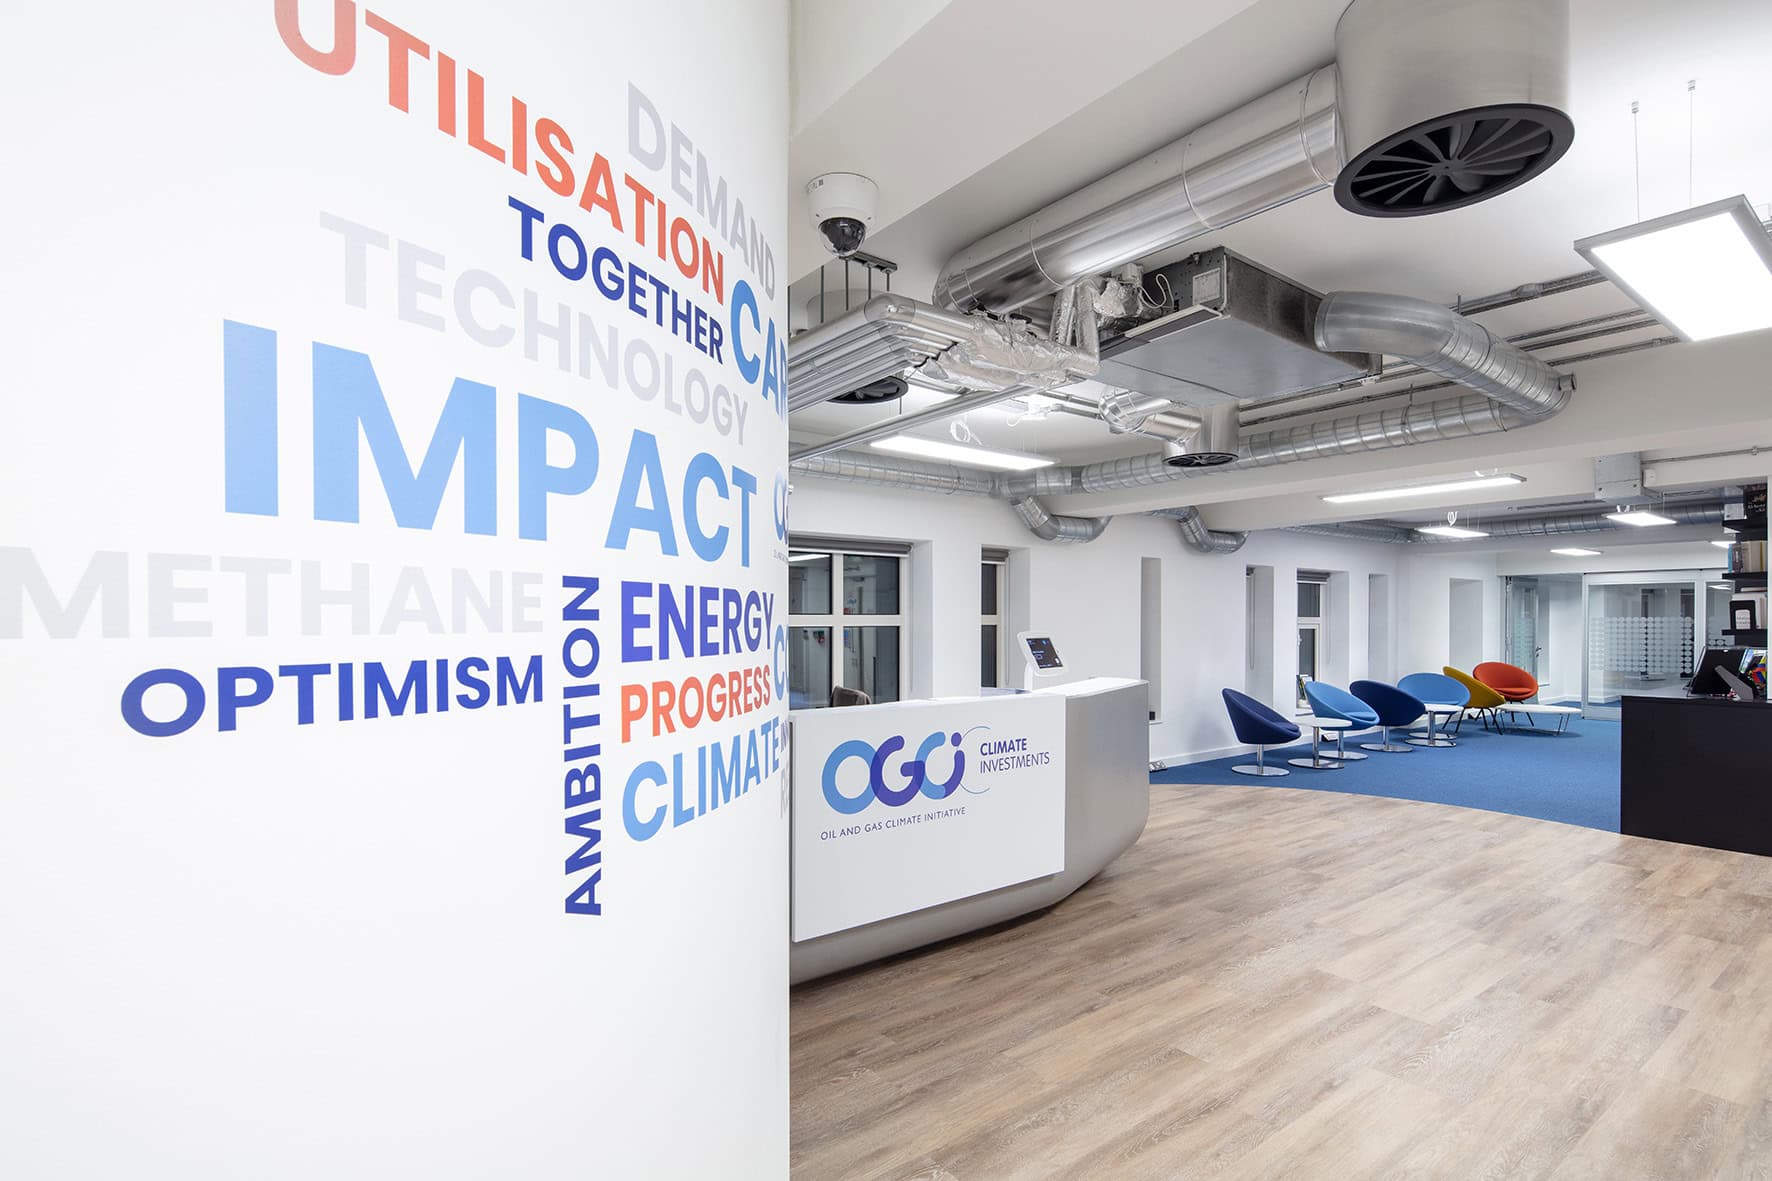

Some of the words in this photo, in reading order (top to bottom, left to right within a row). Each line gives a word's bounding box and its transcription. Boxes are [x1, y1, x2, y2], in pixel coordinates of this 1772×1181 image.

[274, 0, 724, 306] UTILISATION
[627, 80, 776, 301] DEMAND
[320, 210, 748, 446] TECHNOLOGY
[508, 195, 723, 365] TOGETHER
[223, 318, 757, 568] IMPACT
[0, 546, 544, 640] METHANE
[621, 581, 774, 664] ENERGY
[121, 654, 544, 739] OPTIMISM
[562, 574, 602, 916] AMBITION
[621, 664, 771, 744] PROGRESS
[980, 738, 1027, 756] CLIMATE
[622, 716, 780, 843] CLIMATE
[980, 751, 1050, 774] INVESTMENTS
[820, 830, 837, 841] OIL
[839, 825, 861, 837] AND
[864, 821, 883, 833] GAS
[885, 814, 921, 829] CLIMATE
[924, 806, 966, 821] INITIATIVE
